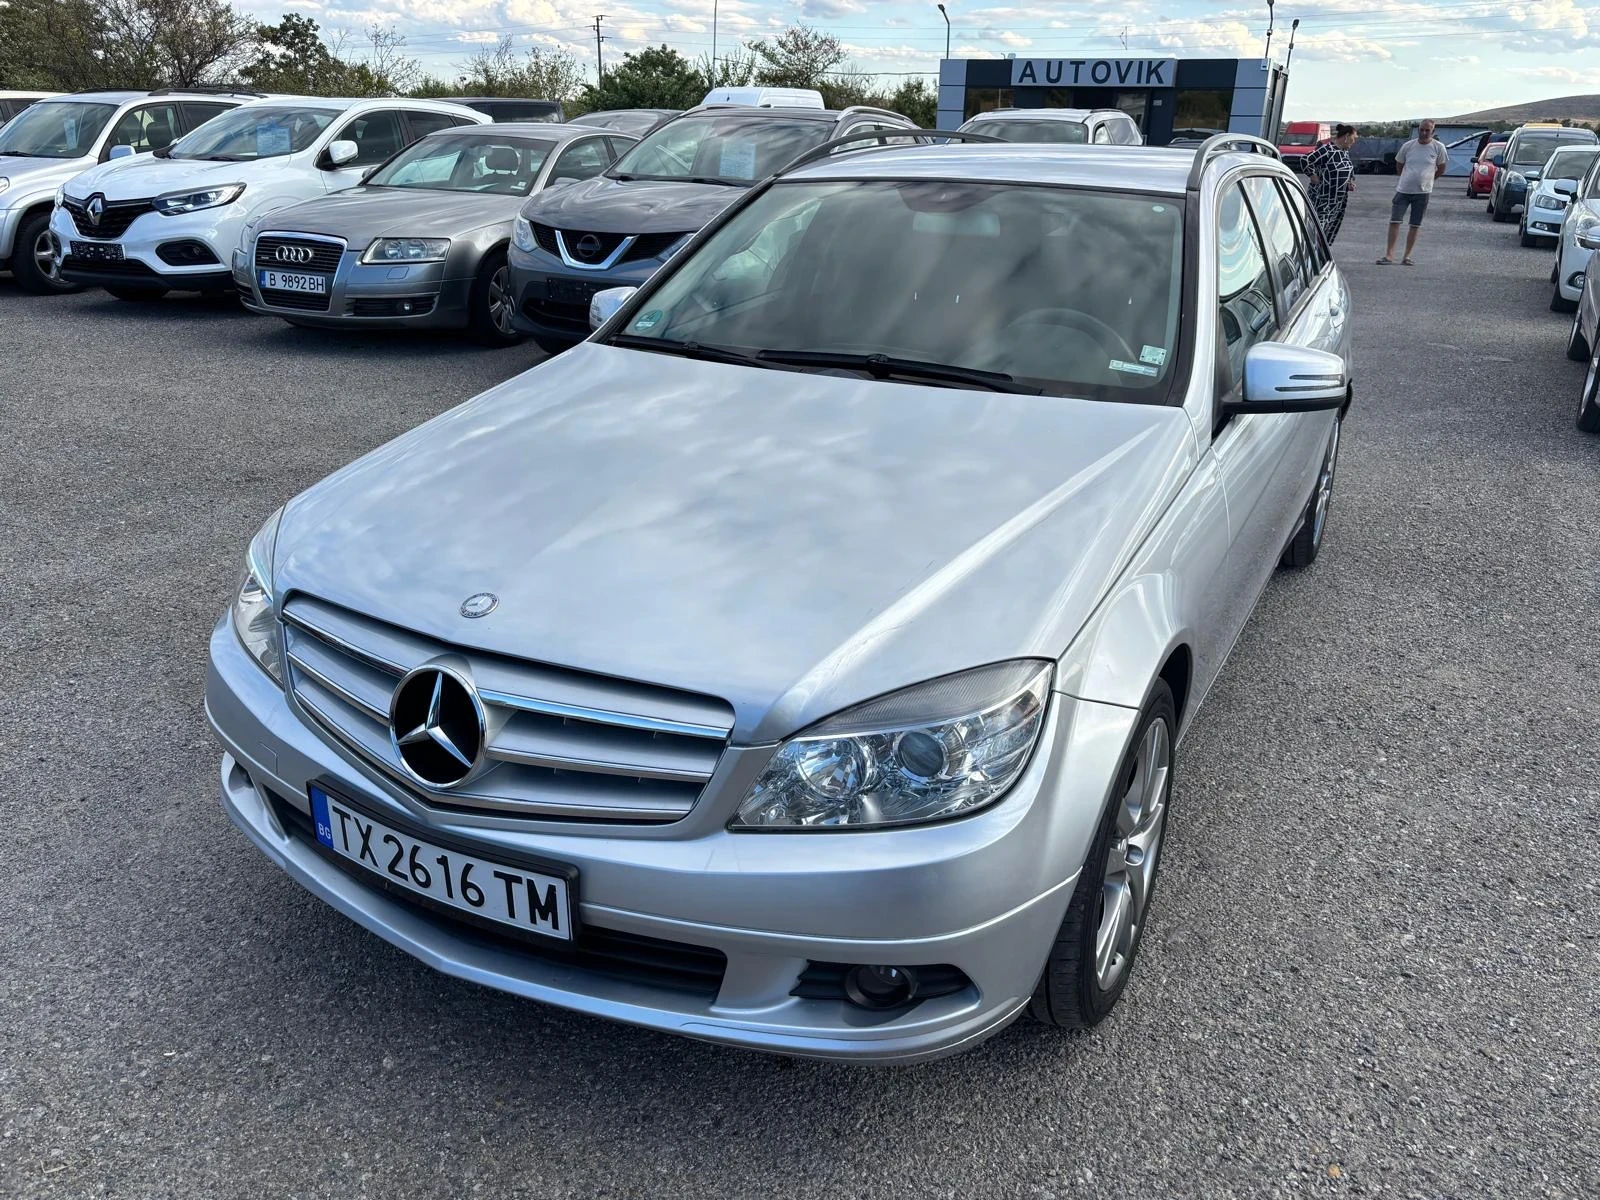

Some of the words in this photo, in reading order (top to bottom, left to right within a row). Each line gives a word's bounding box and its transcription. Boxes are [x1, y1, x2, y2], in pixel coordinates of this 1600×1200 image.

[1019, 61, 1165, 84] AUTOVIK
[318, 822, 331, 840] BG
[493, 870, 559, 930] TM
